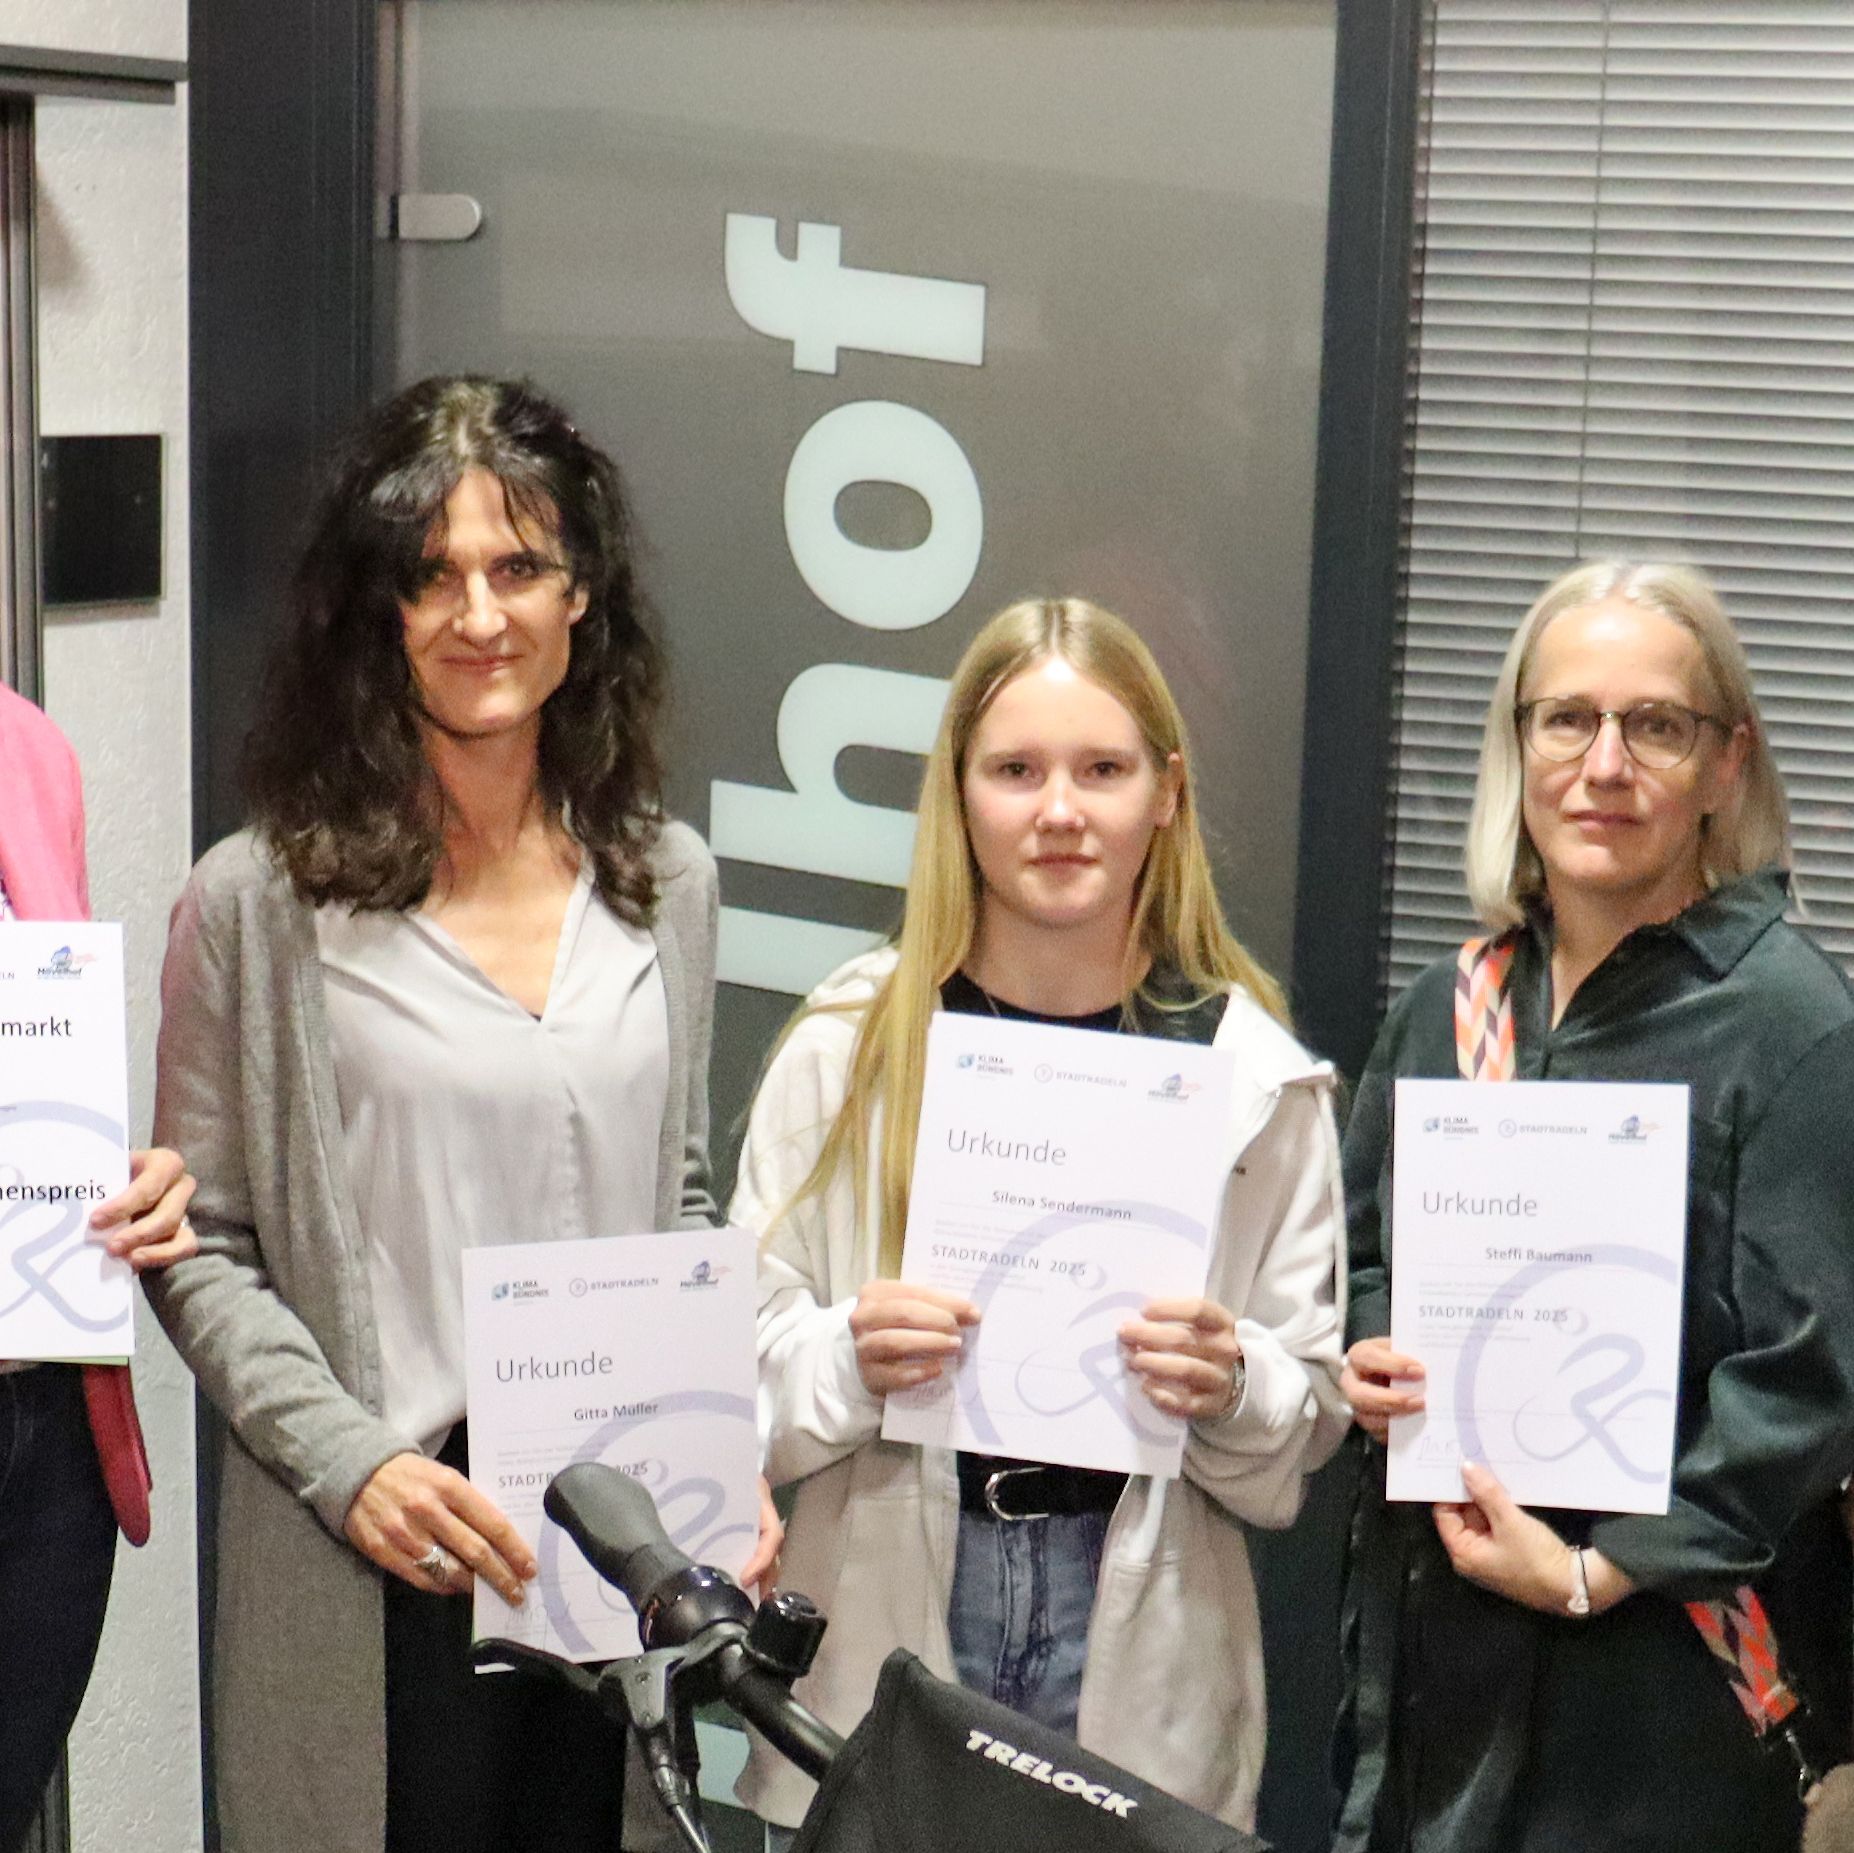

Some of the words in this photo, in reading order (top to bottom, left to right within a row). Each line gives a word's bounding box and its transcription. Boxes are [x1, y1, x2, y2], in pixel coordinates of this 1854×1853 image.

[1056, 1071, 1127, 1088] STADTRADELN
[1519, 1124, 1587, 1135] STADTRADELN
[948, 1128, 1067, 1165] Urkunde
[992, 1190, 1036, 1208] Silena
[1040, 1196, 1132, 1220] Sendermann
[1422, 1190, 1538, 1217] Urkunde
[931, 1244, 1040, 1270] STADTRADELN
[1050, 1260, 1086, 1276] 2025
[1486, 1247, 1522, 1260] Steffi
[1527, 1249, 1593, 1263] Baumann
[590, 1277, 659, 1291] STADTRADELN
[1418, 1305, 1524, 1320] STADTRADELN
[1534, 1309, 1568, 1322] 2025
[495, 1351, 614, 1383] Urkunde
[574, 1407, 608, 1421] Gitta
[612, 1402, 659, 1418] Müller
[965, 1729, 1139, 1818] TRELOCK
